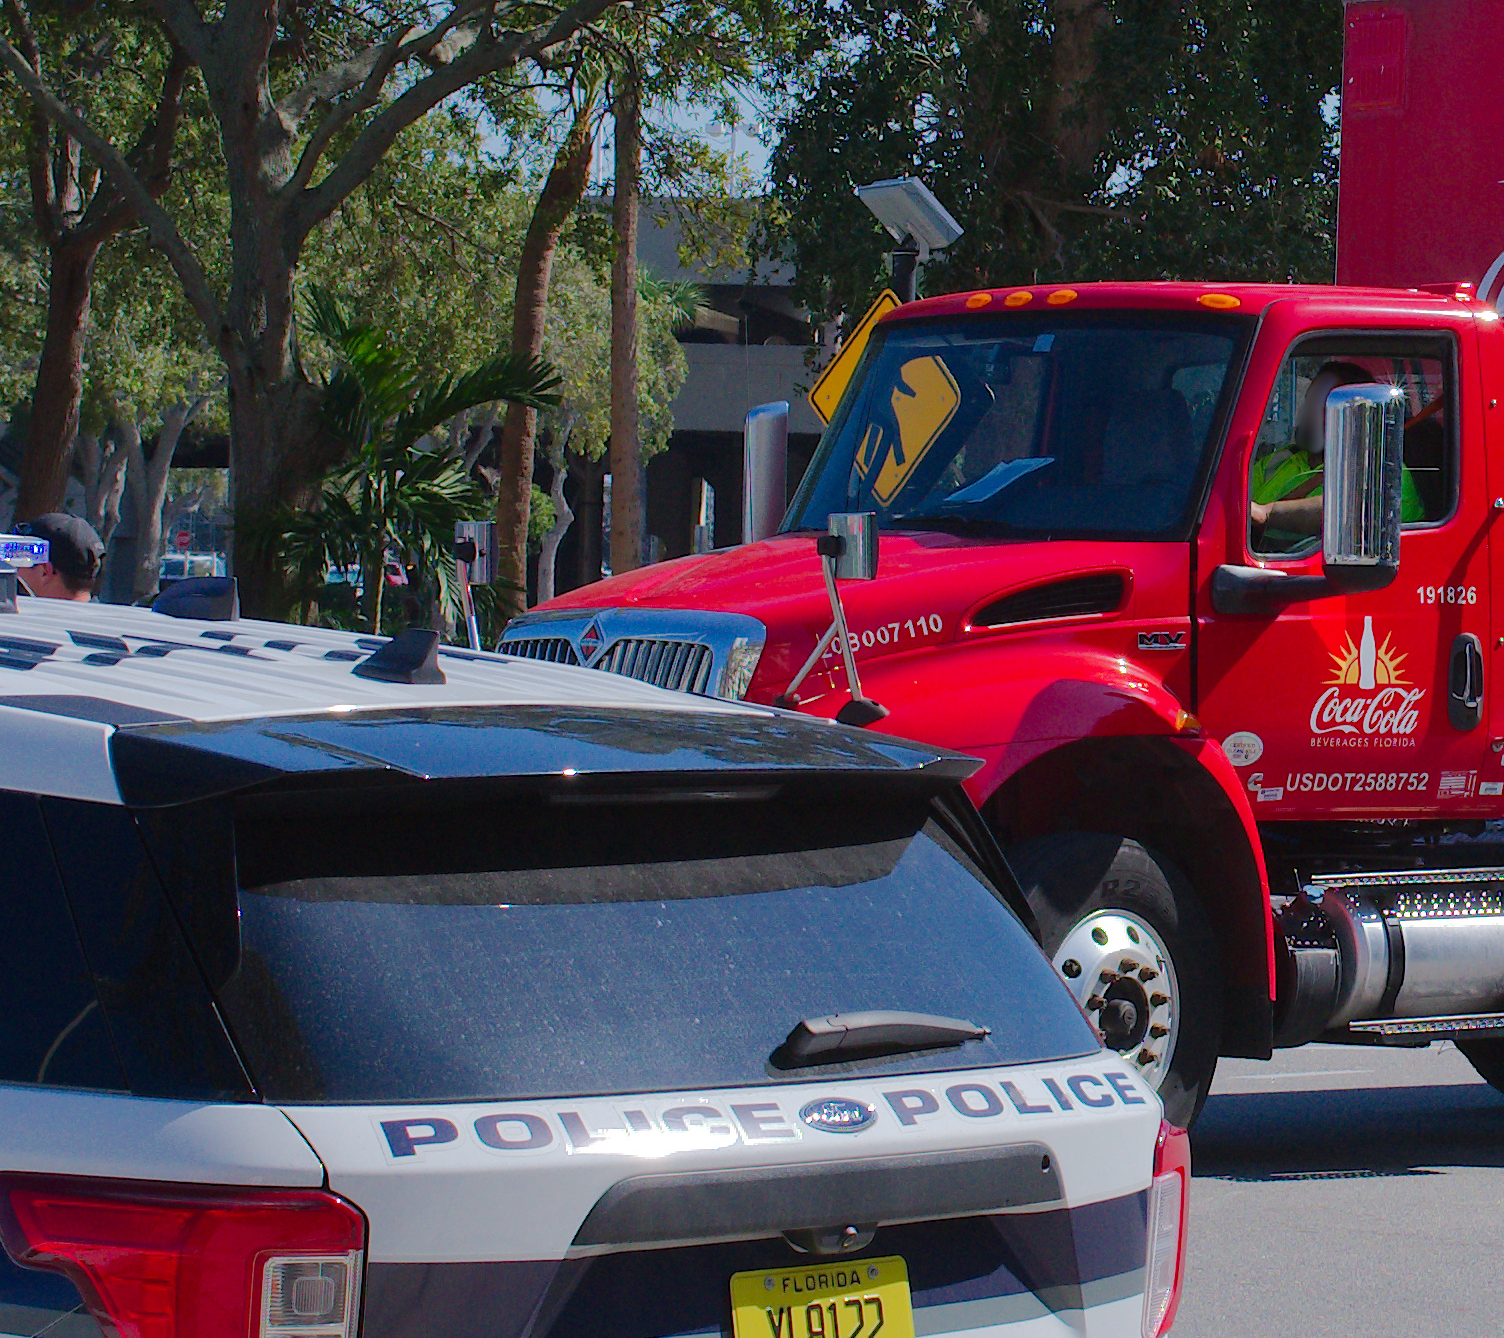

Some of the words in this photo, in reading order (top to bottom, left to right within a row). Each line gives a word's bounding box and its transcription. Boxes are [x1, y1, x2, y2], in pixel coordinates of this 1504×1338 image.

[1416, 585, 1477, 605] 191826
[1137, 631, 1187, 647] MV
[1309, 686, 1427, 735] Coca-Cola
[1310, 736, 1369, 748] BEVERAGES
[1373, 737, 1416, 748] FLORIDA
[1285, 772, 1430, 792] USDOT2588752
[882, 1071, 1147, 1127] POLICE
[379, 1102, 797, 1159] POLICE
[782, 1270, 861, 1294] FLORIDA
